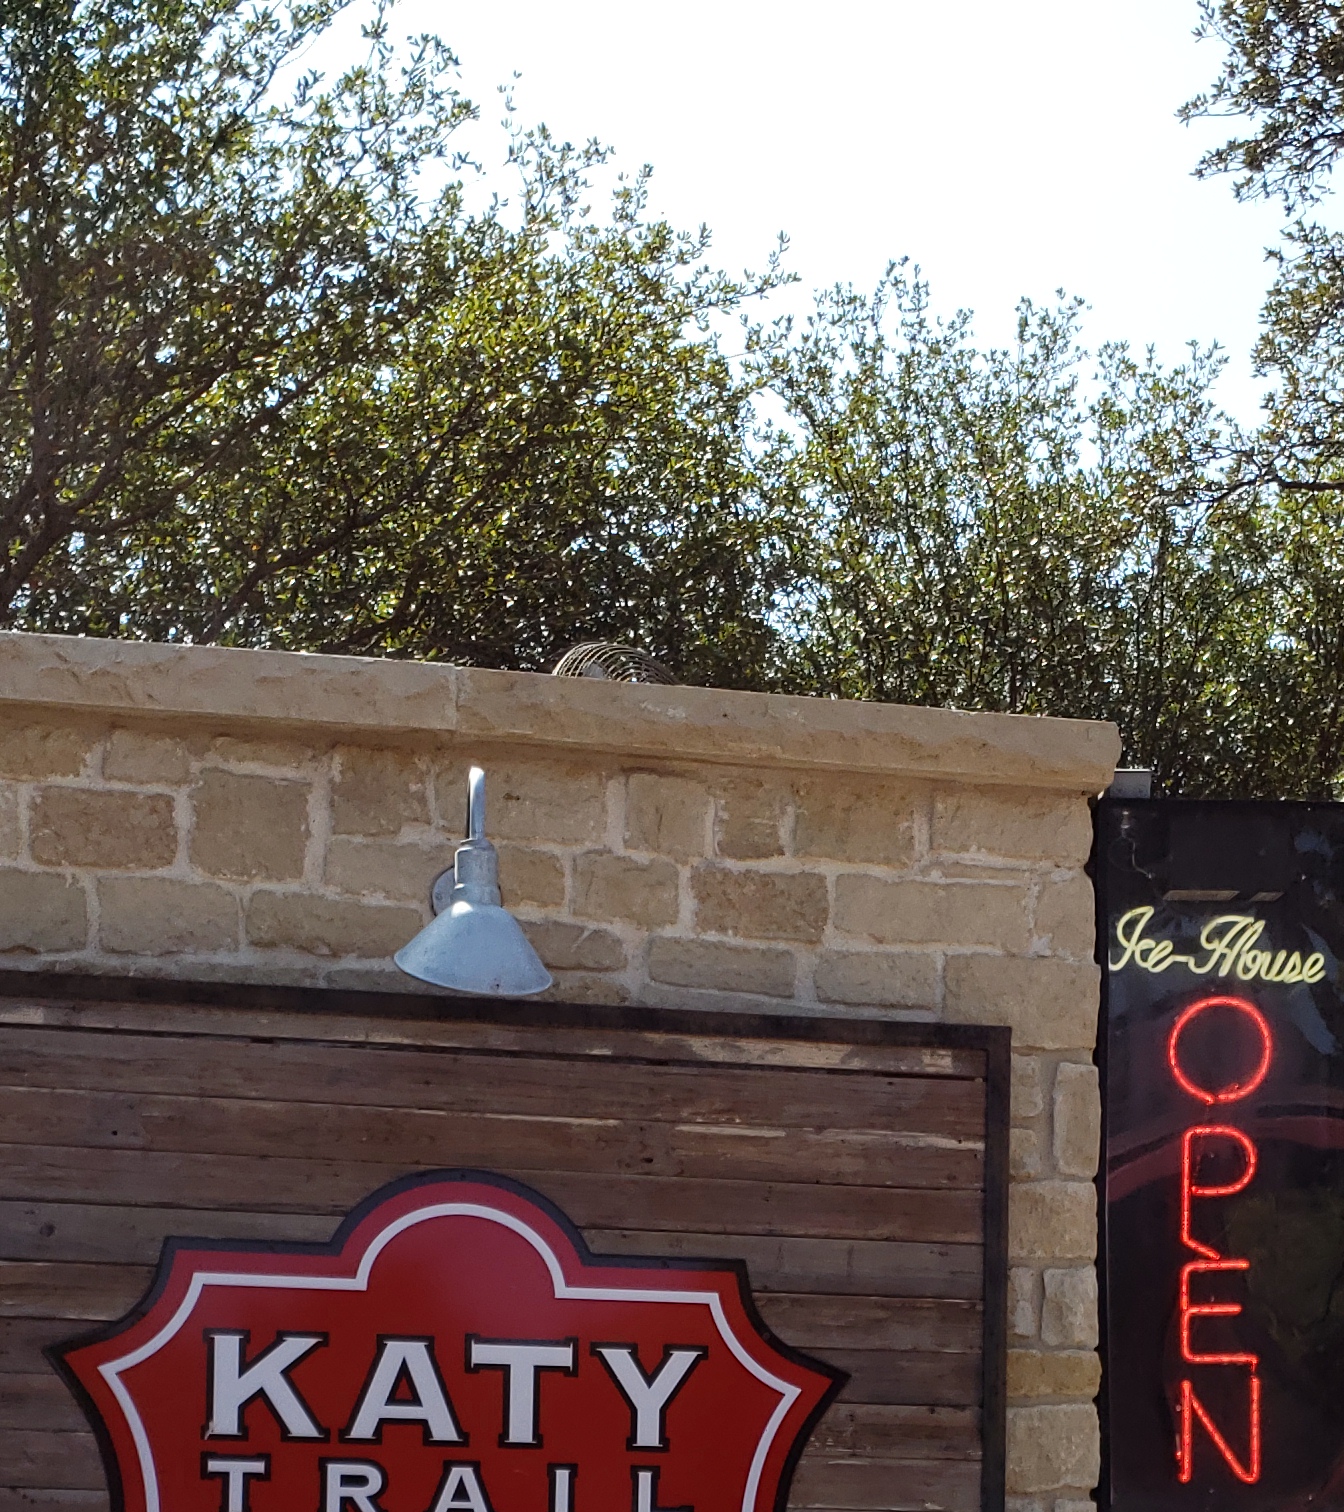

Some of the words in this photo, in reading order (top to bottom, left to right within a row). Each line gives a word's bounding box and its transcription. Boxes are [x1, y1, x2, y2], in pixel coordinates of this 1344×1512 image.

[1108, 905, 1174, 972] Ice
[1187, 915, 1326, 983] House
[1168, 995, 1272, 1484] OPEN
[204, 1332, 706, 1450] KATY
